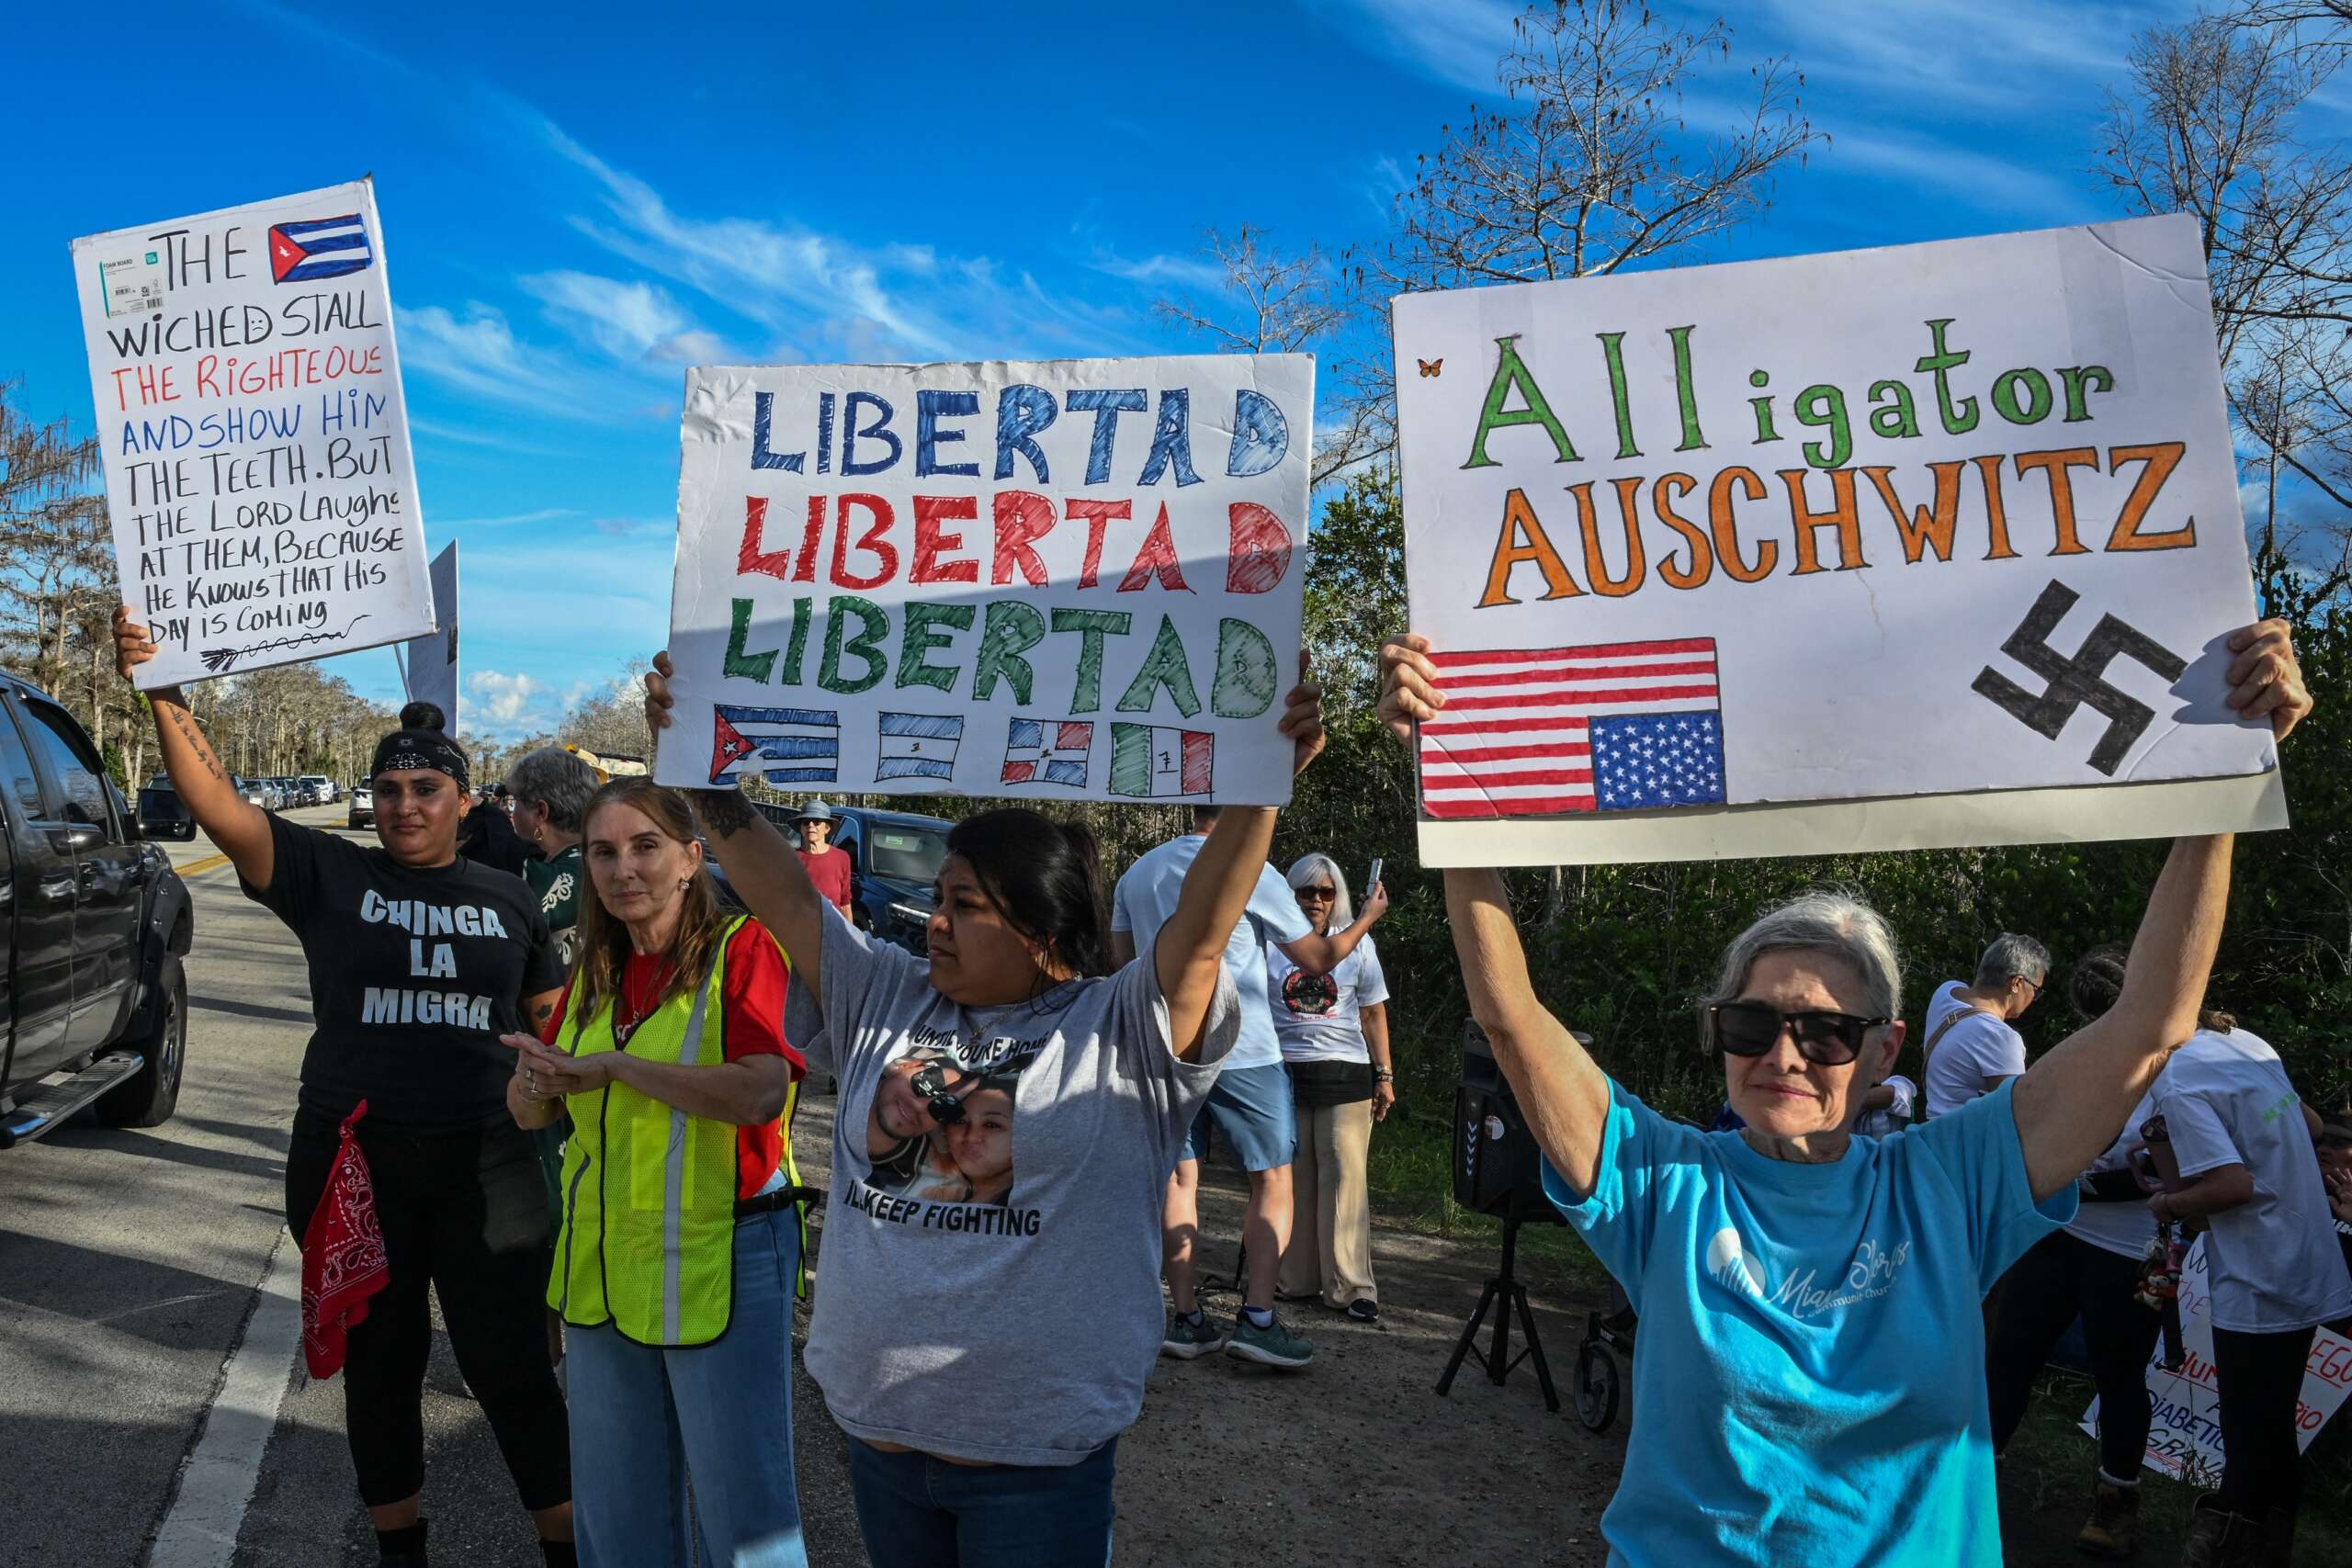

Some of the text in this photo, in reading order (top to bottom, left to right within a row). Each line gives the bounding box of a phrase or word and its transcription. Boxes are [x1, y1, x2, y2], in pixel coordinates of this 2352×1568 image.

[148, 226, 247, 292] THE
[281, 289, 383, 337] STALL
[110, 364, 182, 412] THE
[122, 415, 193, 457] AND
[198, 404, 301, 448] SHOW
[751, 384, 1290, 488] LIBERTAD
[125, 458, 199, 506] THE
[131, 506, 197, 547] THE
[210, 500, 293, 532] LORD
[737, 489, 1293, 595] LIBERTAD
[1474, 441, 2197, 608] AUSCHWITZ
[140, 547, 173, 581] AT
[274, 527, 404, 564] BECAUSE
[145, 583, 177, 615] HE
[187, 576, 270, 610] KNOWS
[147, 615, 190, 653] DAY
[723, 594, 1278, 718] LIBERTAD
[360, 888, 508, 939] CHINGA
[410, 939, 458, 978] LA
[361, 987, 493, 1032] MIGRA
[864, 1189, 921, 1224] KEEP
[922, 1204, 1041, 1237] FIGHTING
